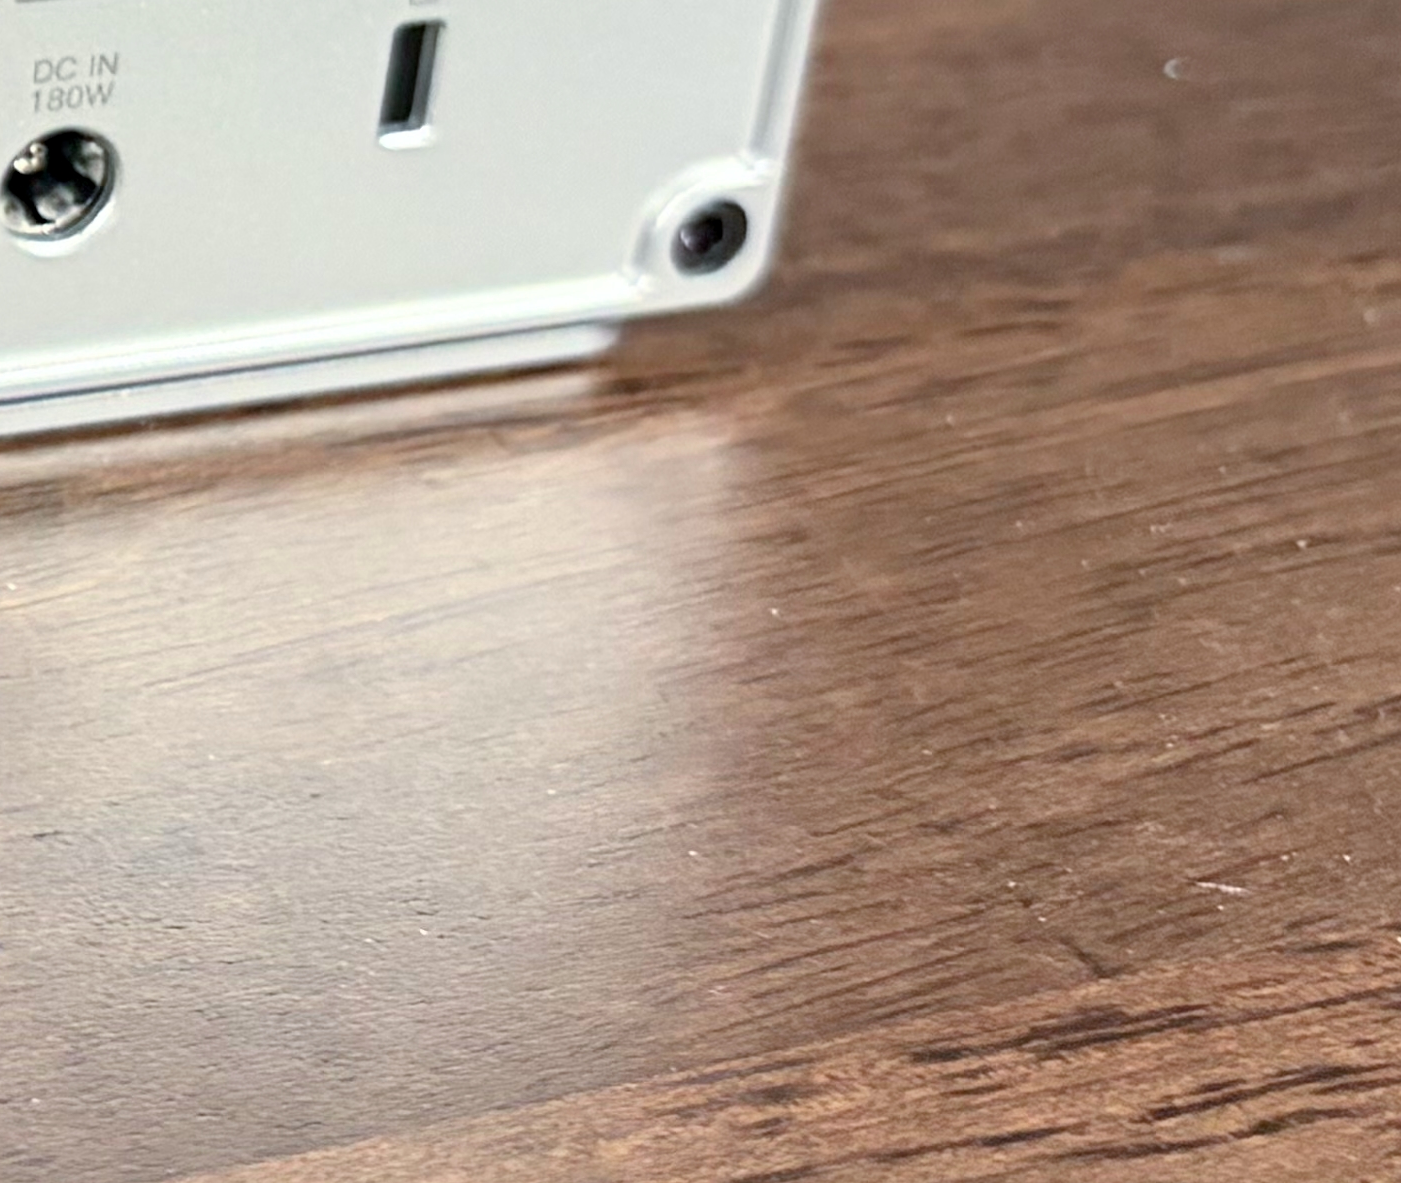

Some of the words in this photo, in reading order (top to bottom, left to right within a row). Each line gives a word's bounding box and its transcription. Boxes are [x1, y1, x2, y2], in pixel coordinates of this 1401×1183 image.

[33, 56, 79, 84] DC
[89, 53, 119, 79] IN
[31, 83, 115, 113] 180W
